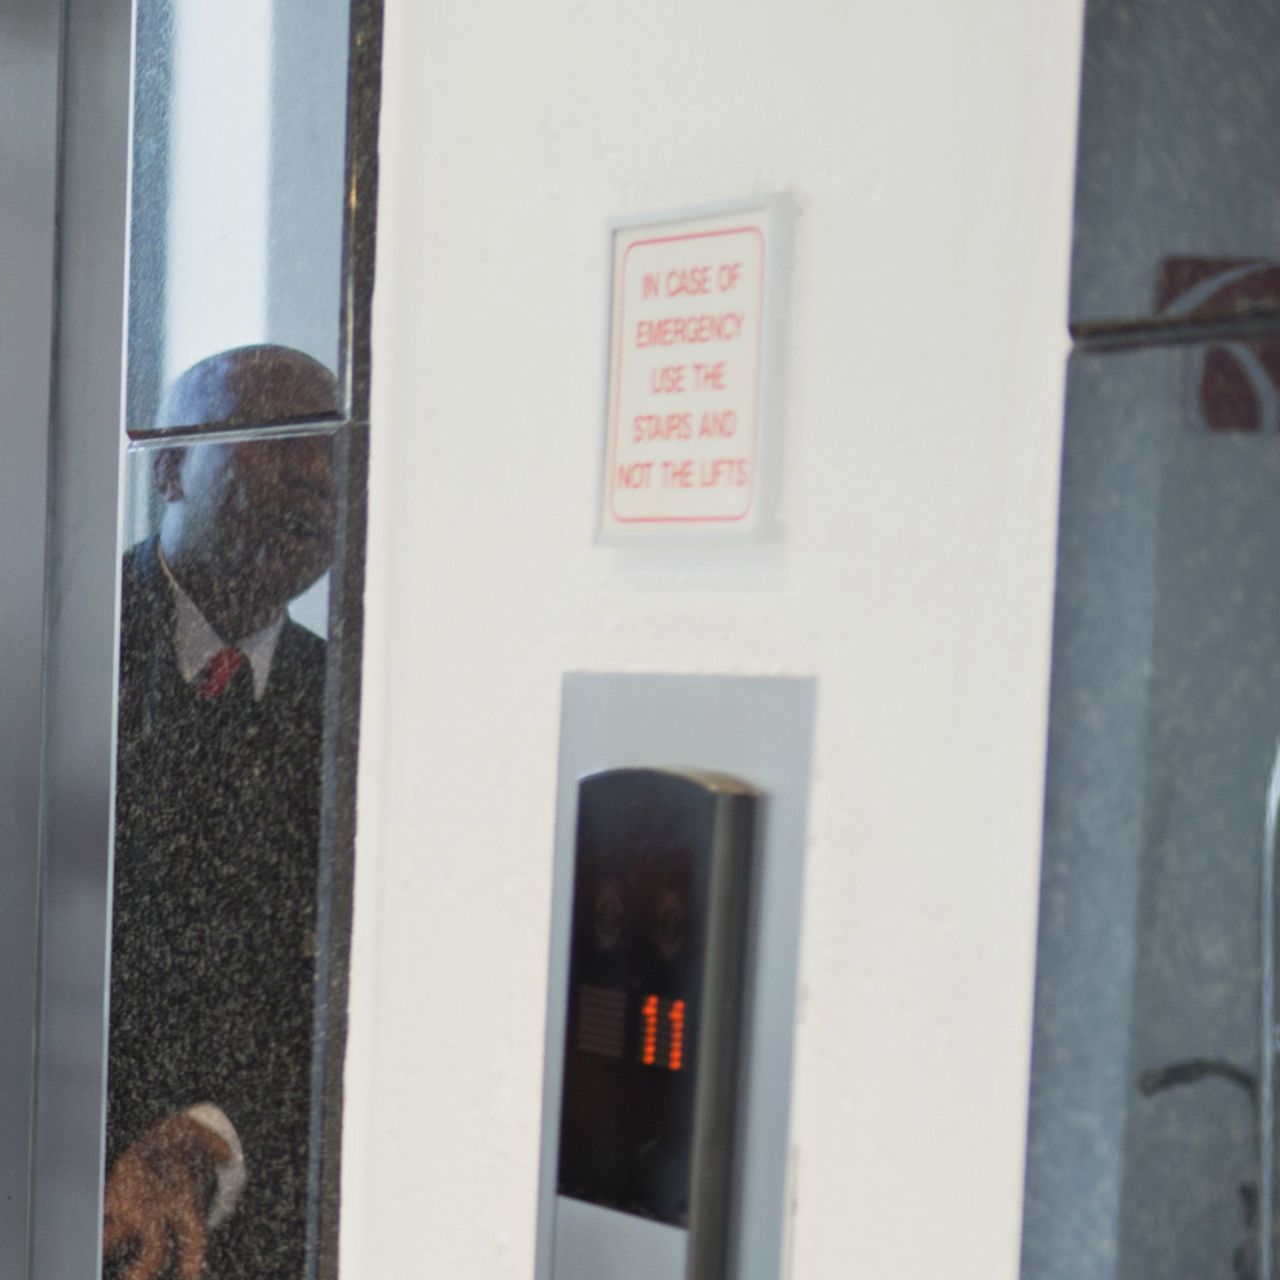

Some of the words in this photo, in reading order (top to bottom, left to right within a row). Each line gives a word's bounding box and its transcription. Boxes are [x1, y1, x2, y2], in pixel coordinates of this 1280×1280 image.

[642, 272, 660, 300] IN
[665, 265, 712, 297] CASE
[717, 261, 744, 293] OF
[635, 312, 745, 348] EMERGENCY
[649, 364, 686, 394] USE
[692, 360, 727, 392] THE
[633, 411, 692, 443] STAIRS
[698, 409, 737, 438] AND
[618, 461, 654, 488] NOT
[661, 459, 694, 488] THE
[700, 458, 749, 487] LIFTS
[641, 995, 685, 1071] 11
